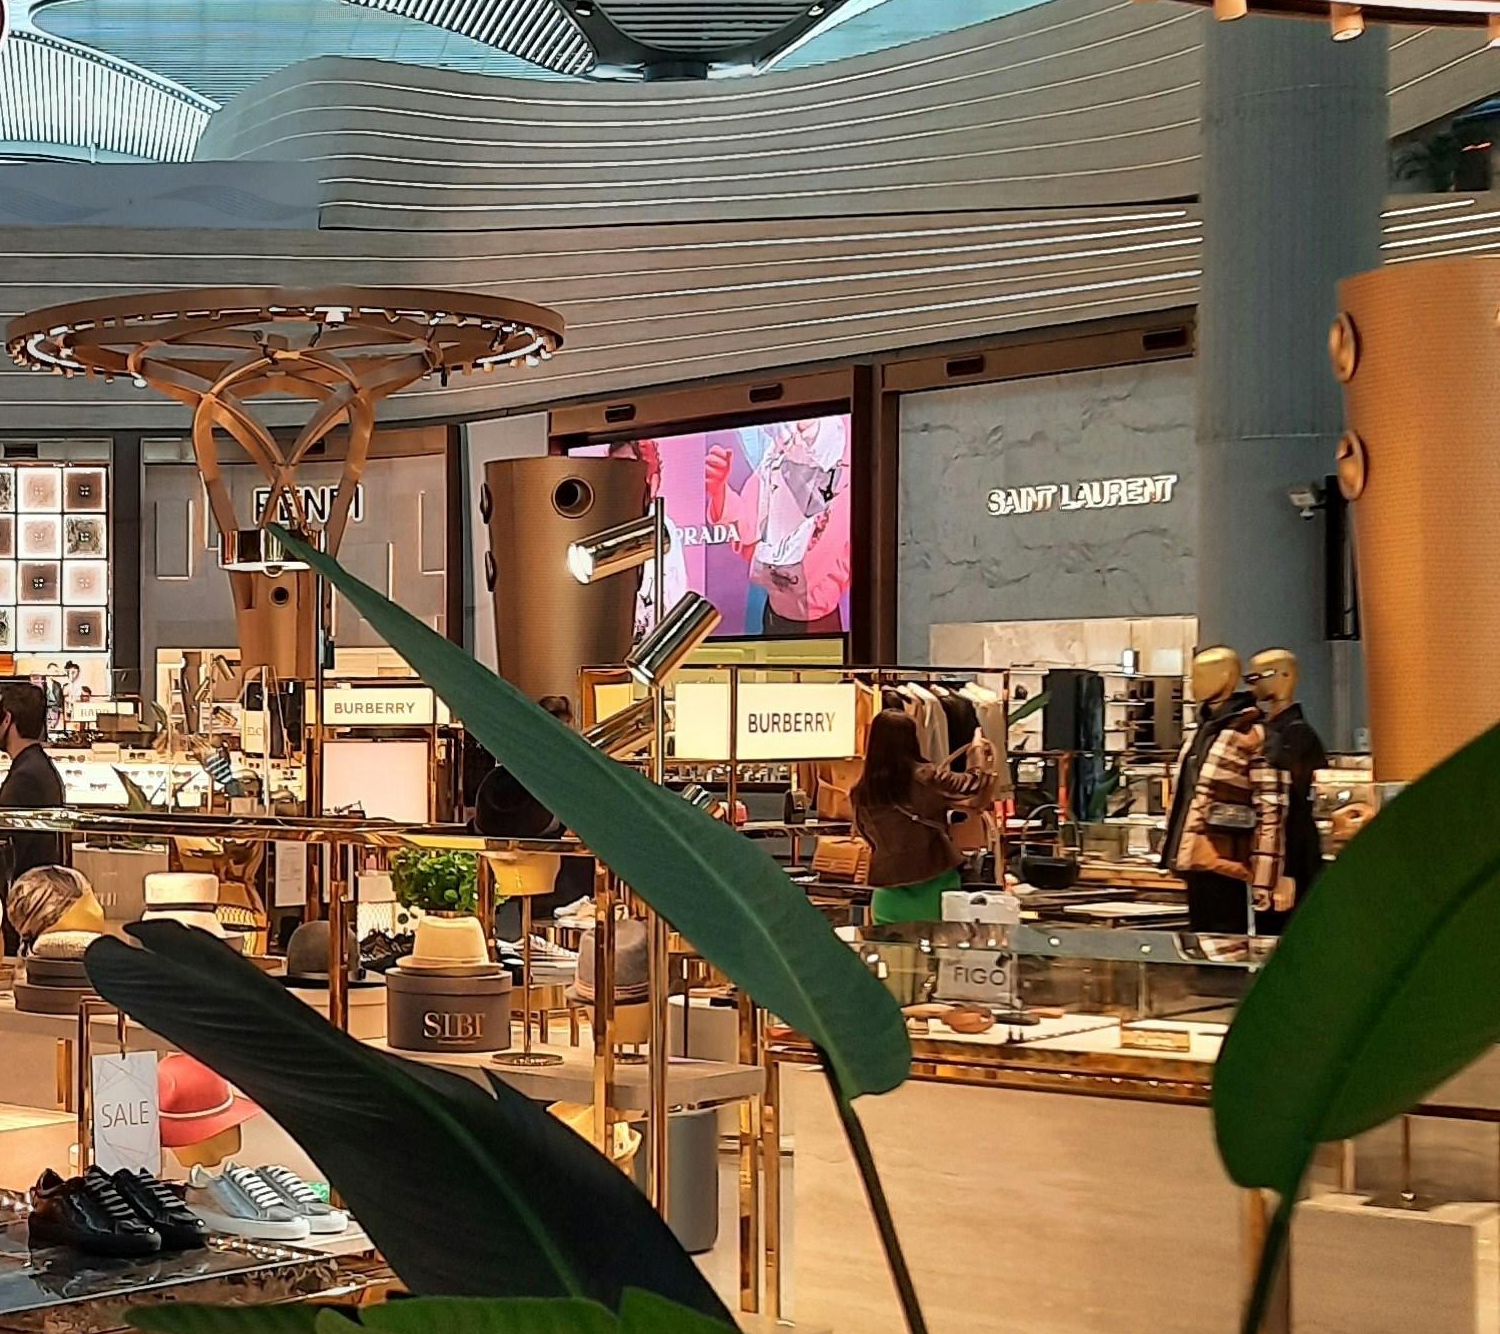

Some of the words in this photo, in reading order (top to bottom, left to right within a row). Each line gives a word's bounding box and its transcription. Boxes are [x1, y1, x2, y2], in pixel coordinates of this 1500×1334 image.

[987, 484, 1057, 516] SAINT
[1058, 474, 1179, 511] LAURENT
[671, 523, 741, 546] PRADA
[334, 701, 416, 714] BURBERRY
[747, 711, 836, 733] BURBERRY
[953, 966, 1007, 987] FIGO
[100, 1098, 150, 1129] SALE
